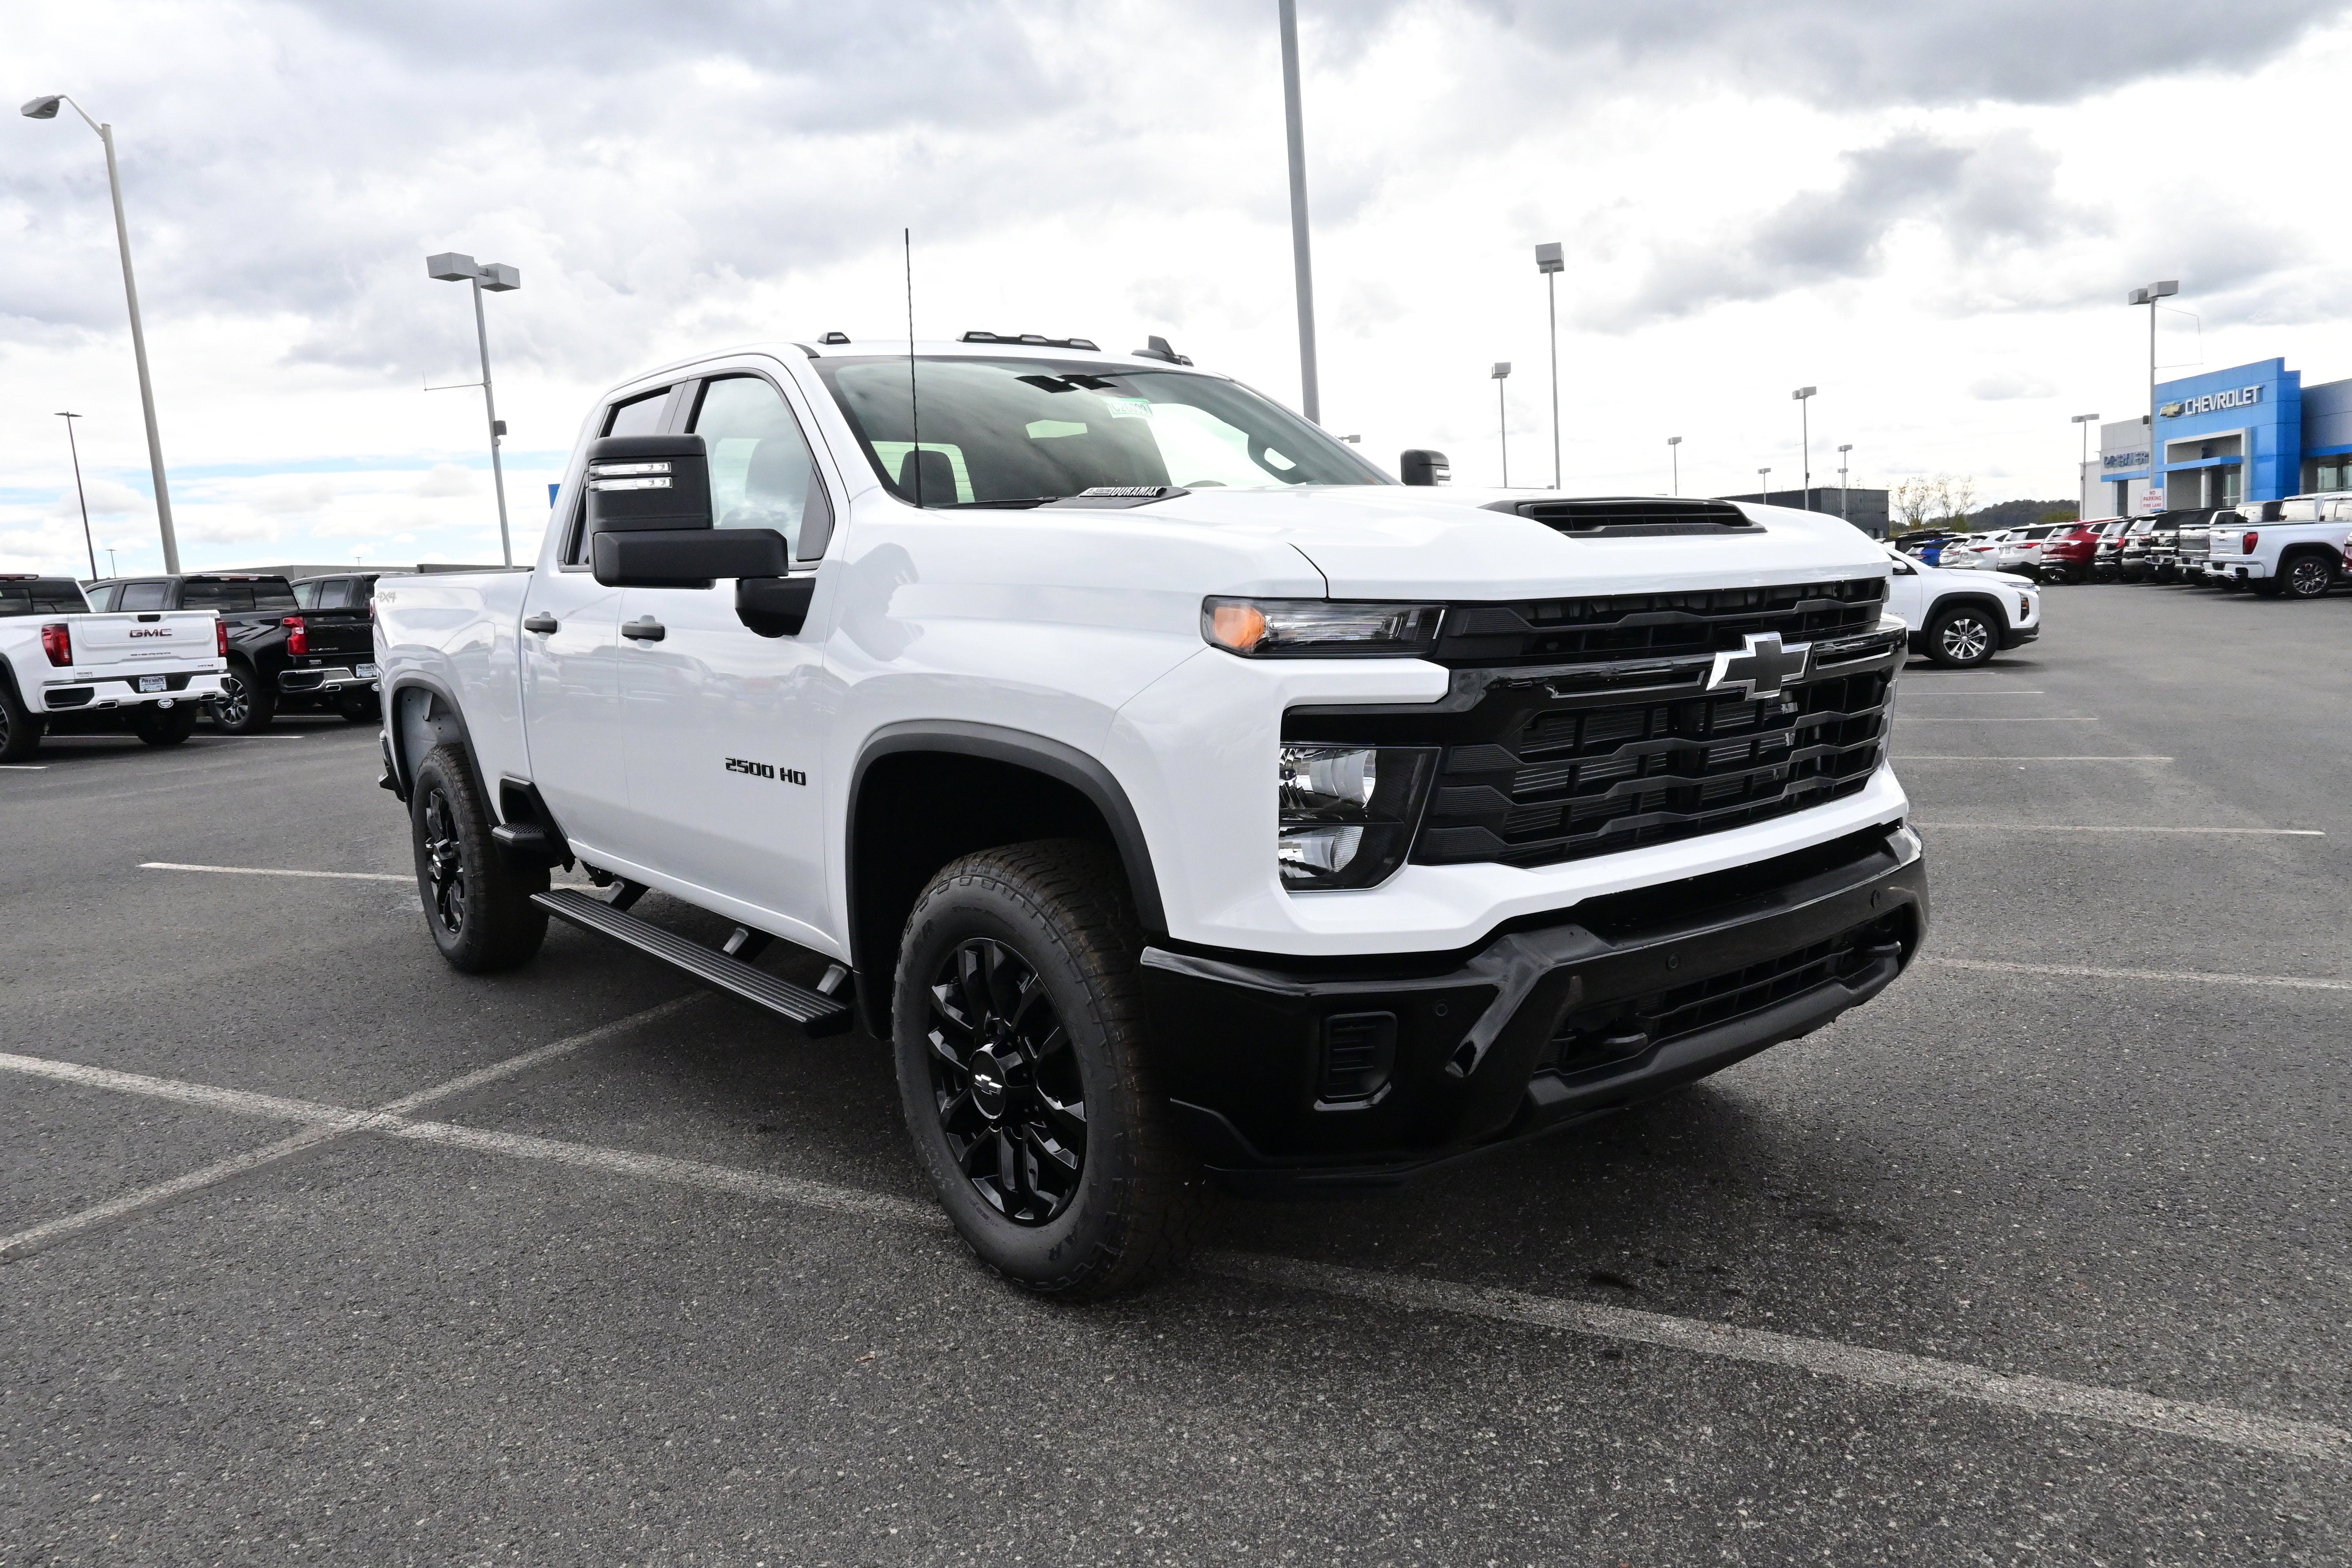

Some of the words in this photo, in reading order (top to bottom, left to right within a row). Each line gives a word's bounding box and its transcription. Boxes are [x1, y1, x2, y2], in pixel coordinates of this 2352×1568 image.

[2185, 385, 2260, 415] CHEVROLET
[1110, 487, 1162, 496] DURAMAX
[130, 628, 172, 638] GMC
[725, 756, 774, 779] 2500
[779, 766, 806, 786] HD
